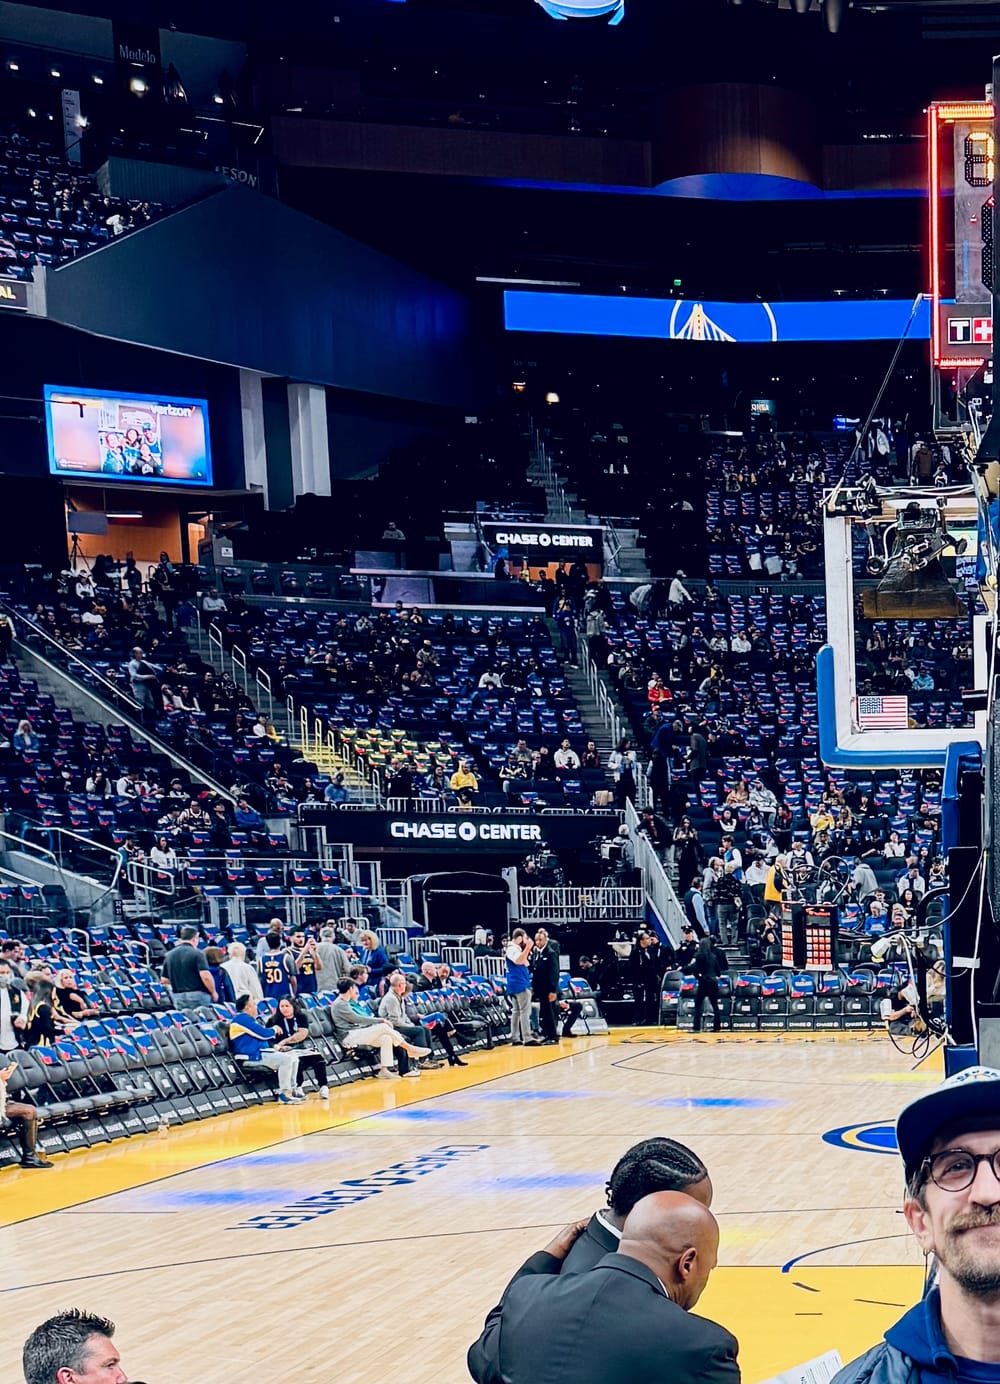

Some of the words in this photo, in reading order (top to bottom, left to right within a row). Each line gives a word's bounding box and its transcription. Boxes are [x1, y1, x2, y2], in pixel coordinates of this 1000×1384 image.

[119, 44, 156, 64] Modelo
[150, 404, 192, 417] verizon
[495, 532, 539, 545] CHASE
[551, 534, 594, 547] CENTER
[390, 822, 457, 838] CHASE
[479, 824, 542, 840] CENTER
[264, 968, 283, 984] 30
